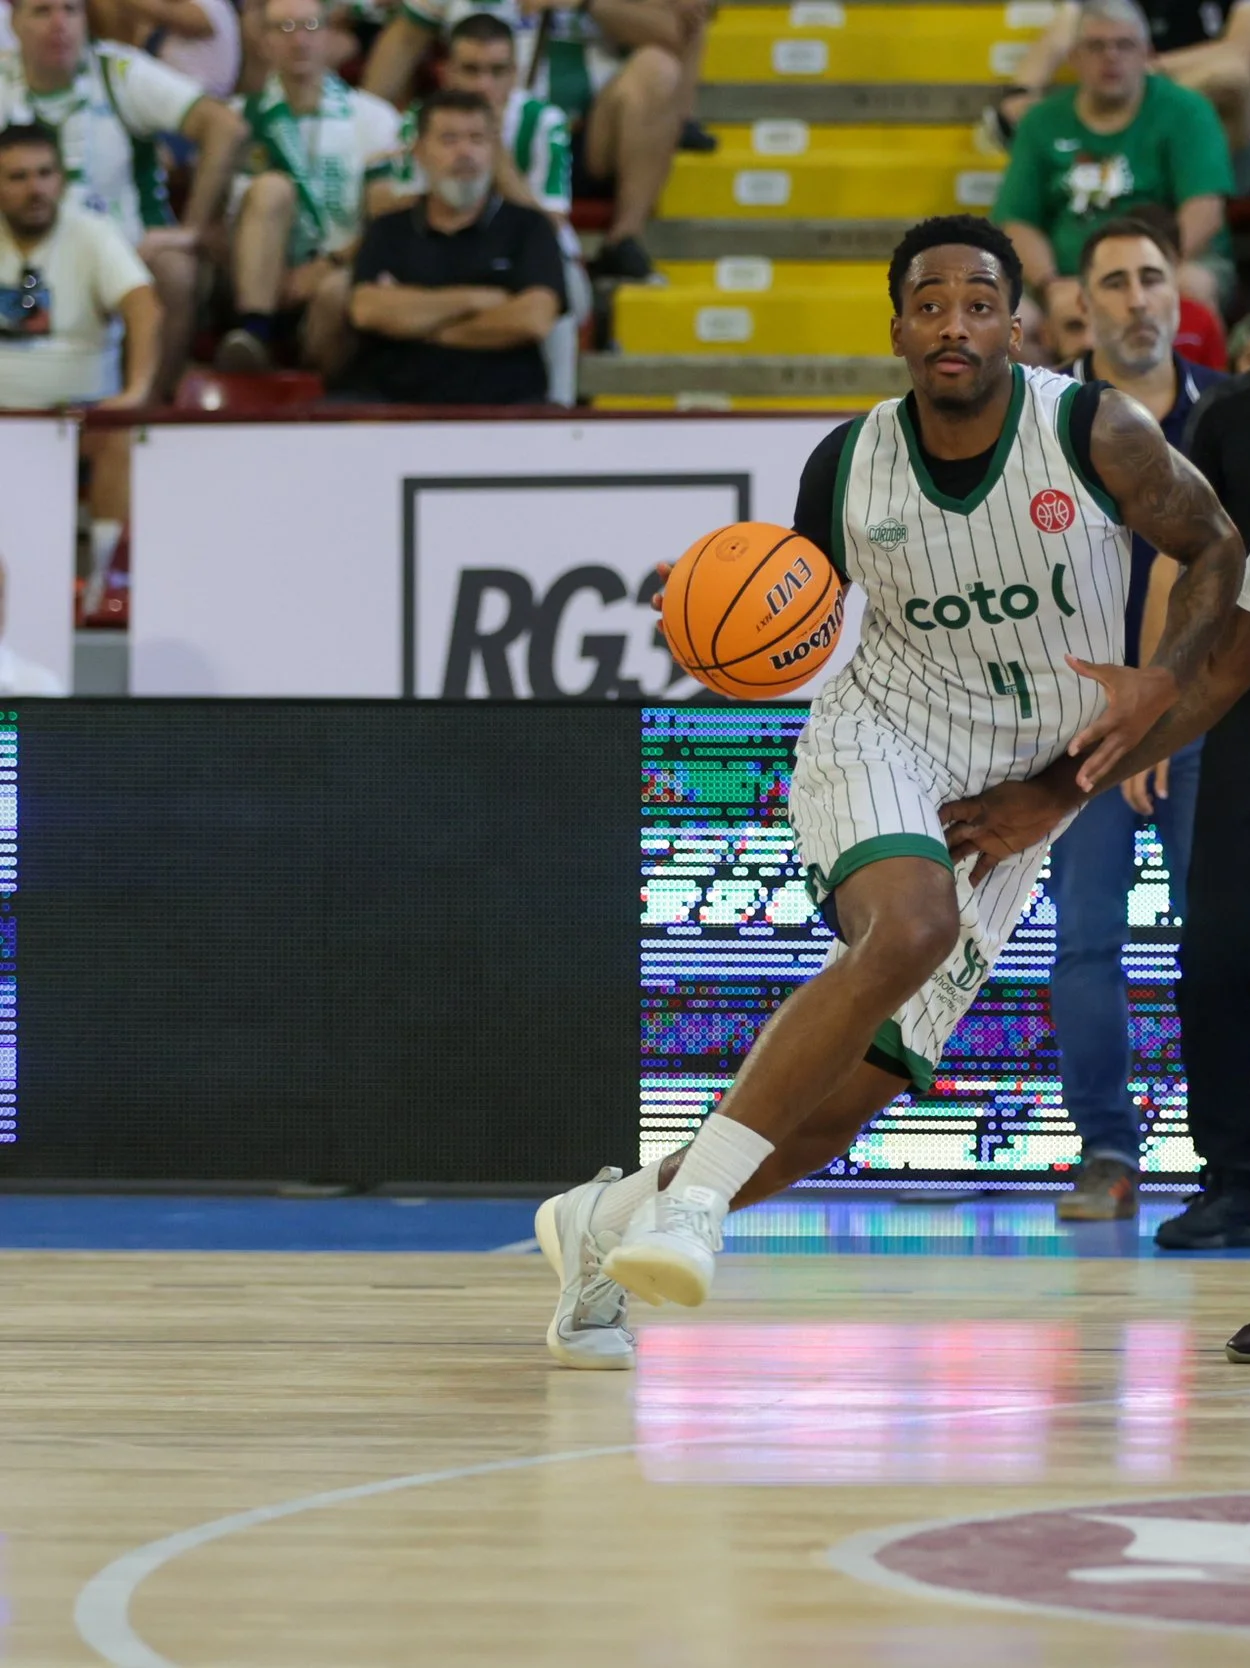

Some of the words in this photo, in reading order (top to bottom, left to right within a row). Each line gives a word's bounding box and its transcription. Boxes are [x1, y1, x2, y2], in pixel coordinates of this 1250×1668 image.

[765, 556, 813, 616] EVO
[769, 588, 844, 671] Wilson
[987, 660, 1033, 720] 4
